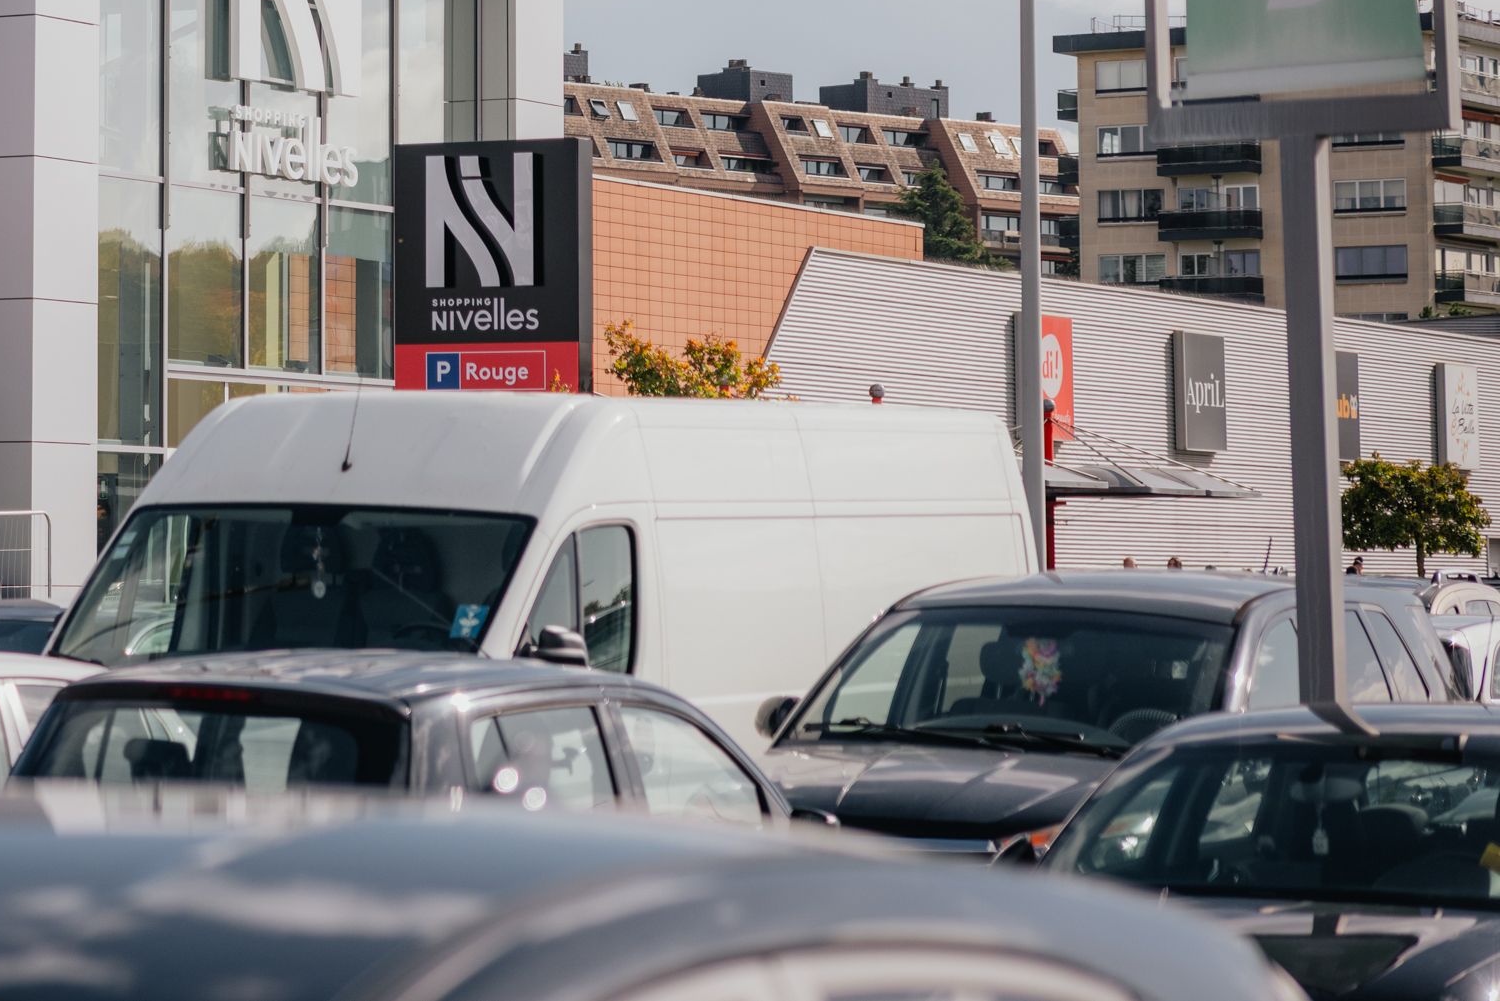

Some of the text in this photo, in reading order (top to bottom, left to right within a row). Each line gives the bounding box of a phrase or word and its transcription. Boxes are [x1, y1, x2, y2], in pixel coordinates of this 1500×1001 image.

[234, 104, 306, 128] SHOPPING
[431, 297, 492, 307] SHOPPING
[436, 360, 529, 386] P Rouge
[1451, 398, 1475, 416] La Vita
[1458, 417, 1476, 435] Bella
